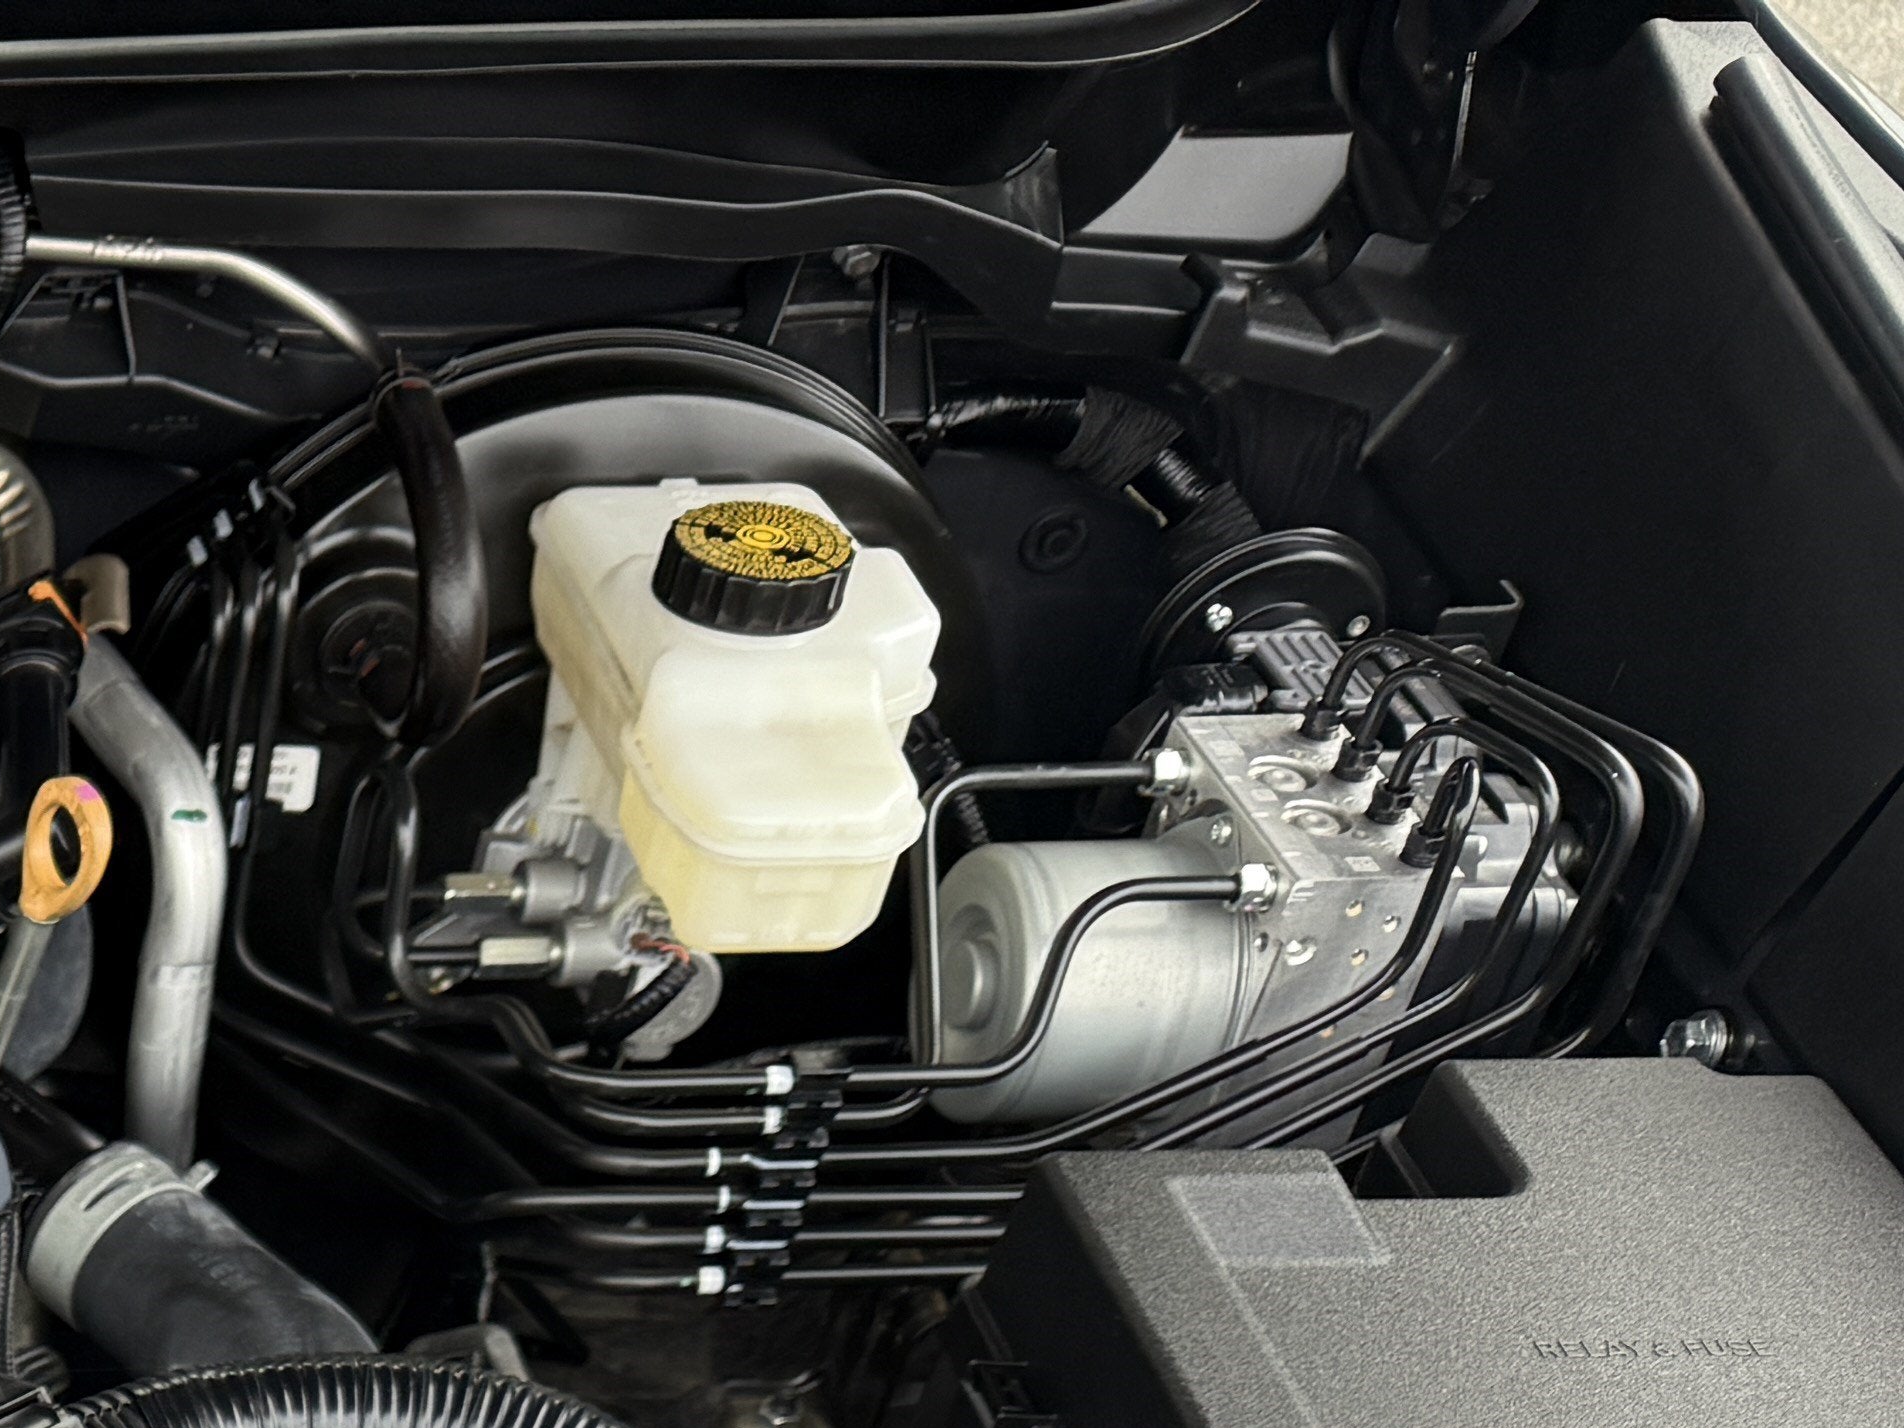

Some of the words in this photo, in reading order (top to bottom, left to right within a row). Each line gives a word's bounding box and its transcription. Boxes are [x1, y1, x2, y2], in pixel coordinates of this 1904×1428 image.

[1533, 1340, 1640, 1360] RELAY
[1652, 1341, 1676, 1358] &
[1686, 1339, 1774, 1358] FUSE
